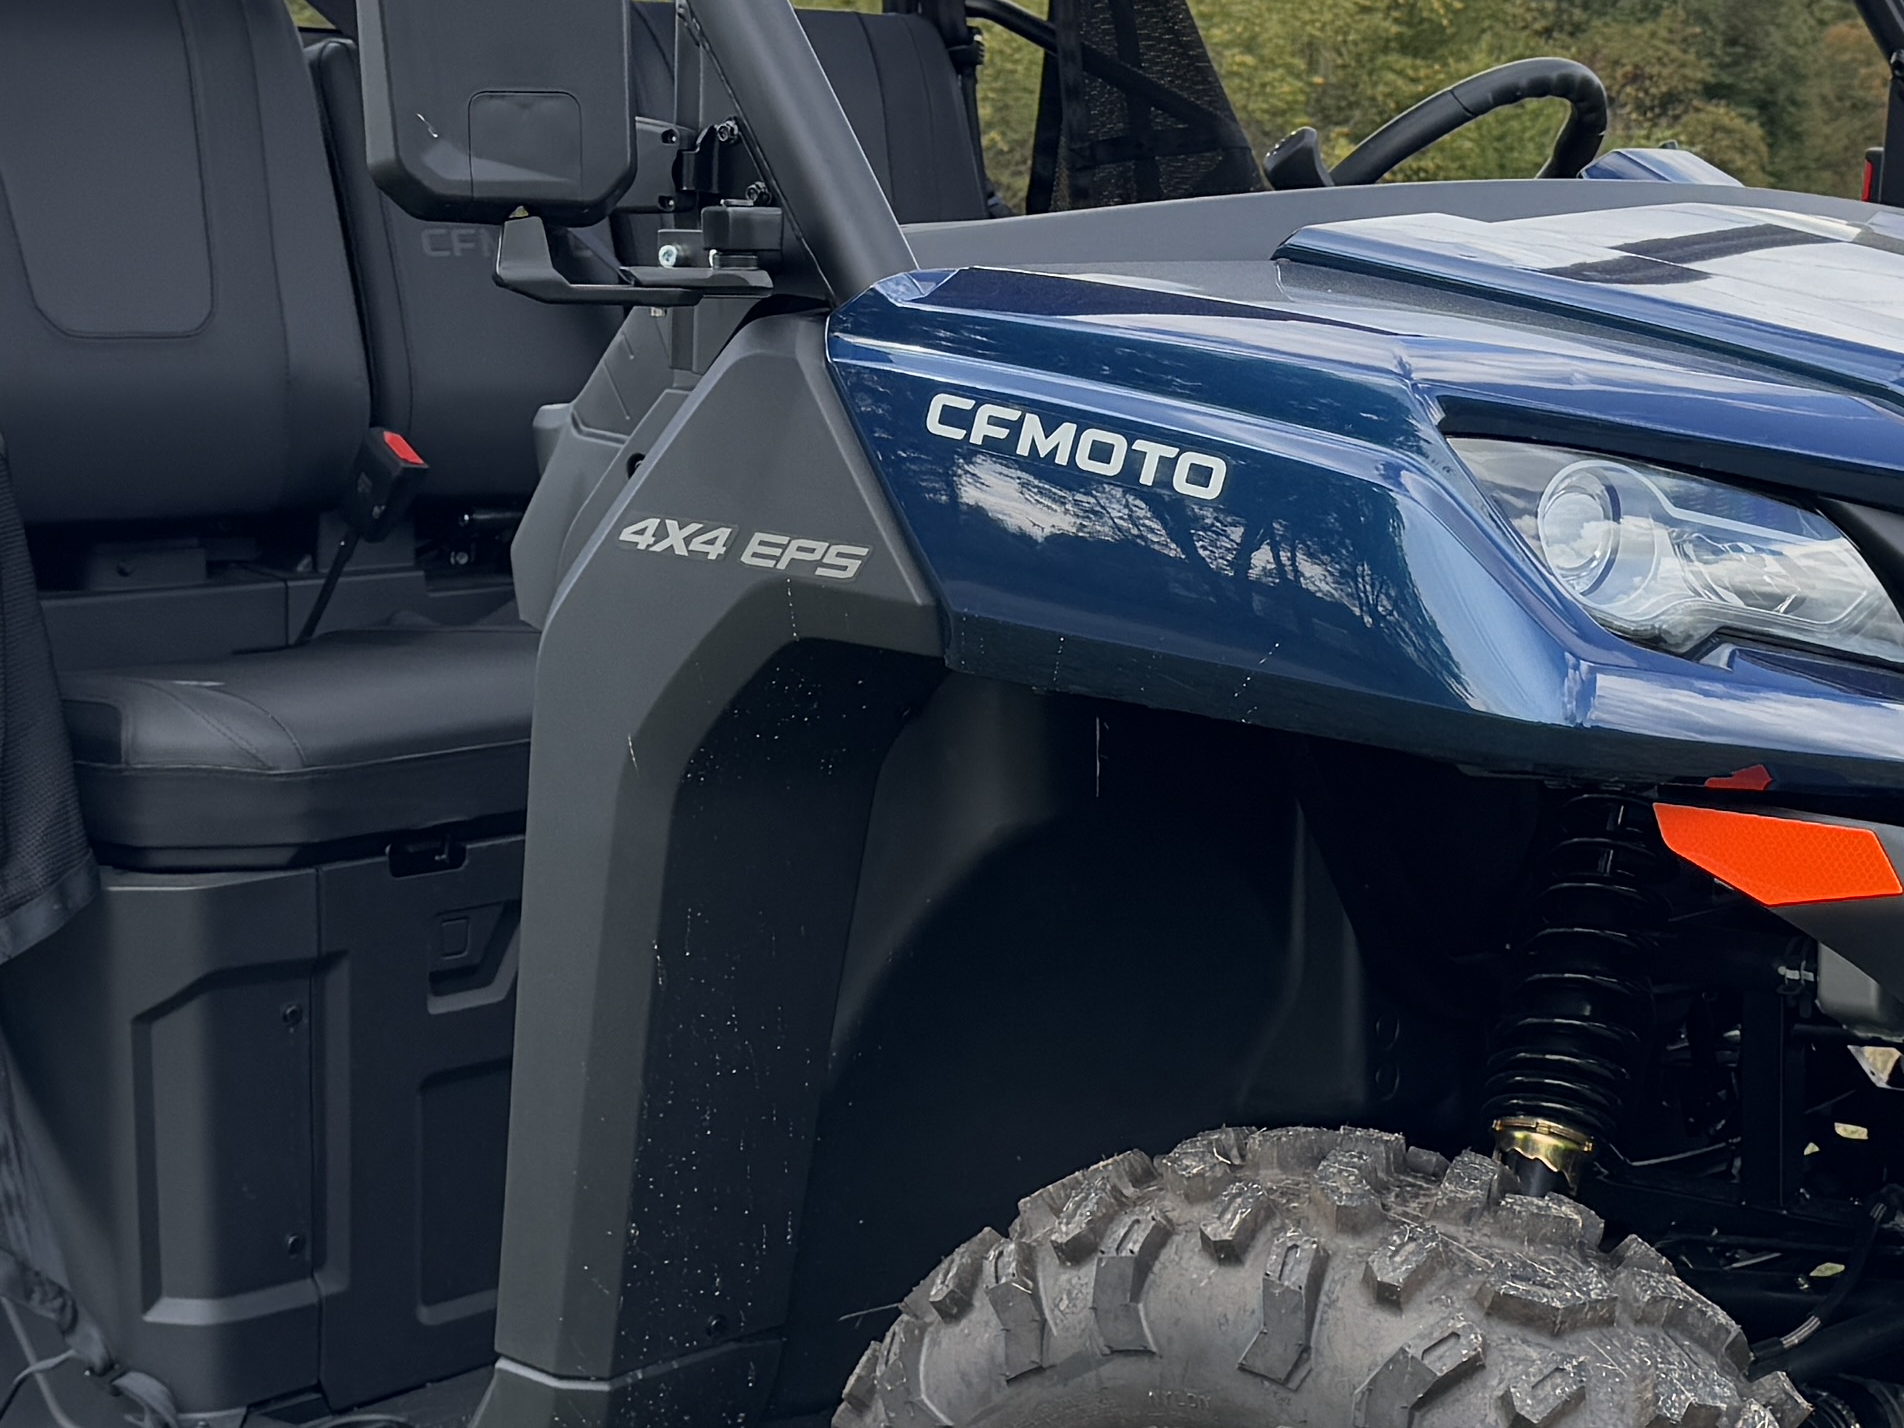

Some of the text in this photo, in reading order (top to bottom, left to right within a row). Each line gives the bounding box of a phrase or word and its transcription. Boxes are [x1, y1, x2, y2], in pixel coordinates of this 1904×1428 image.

[926, 392, 1227, 501] CFMOTO
[620, 517, 871, 579] 4X4 EPS
